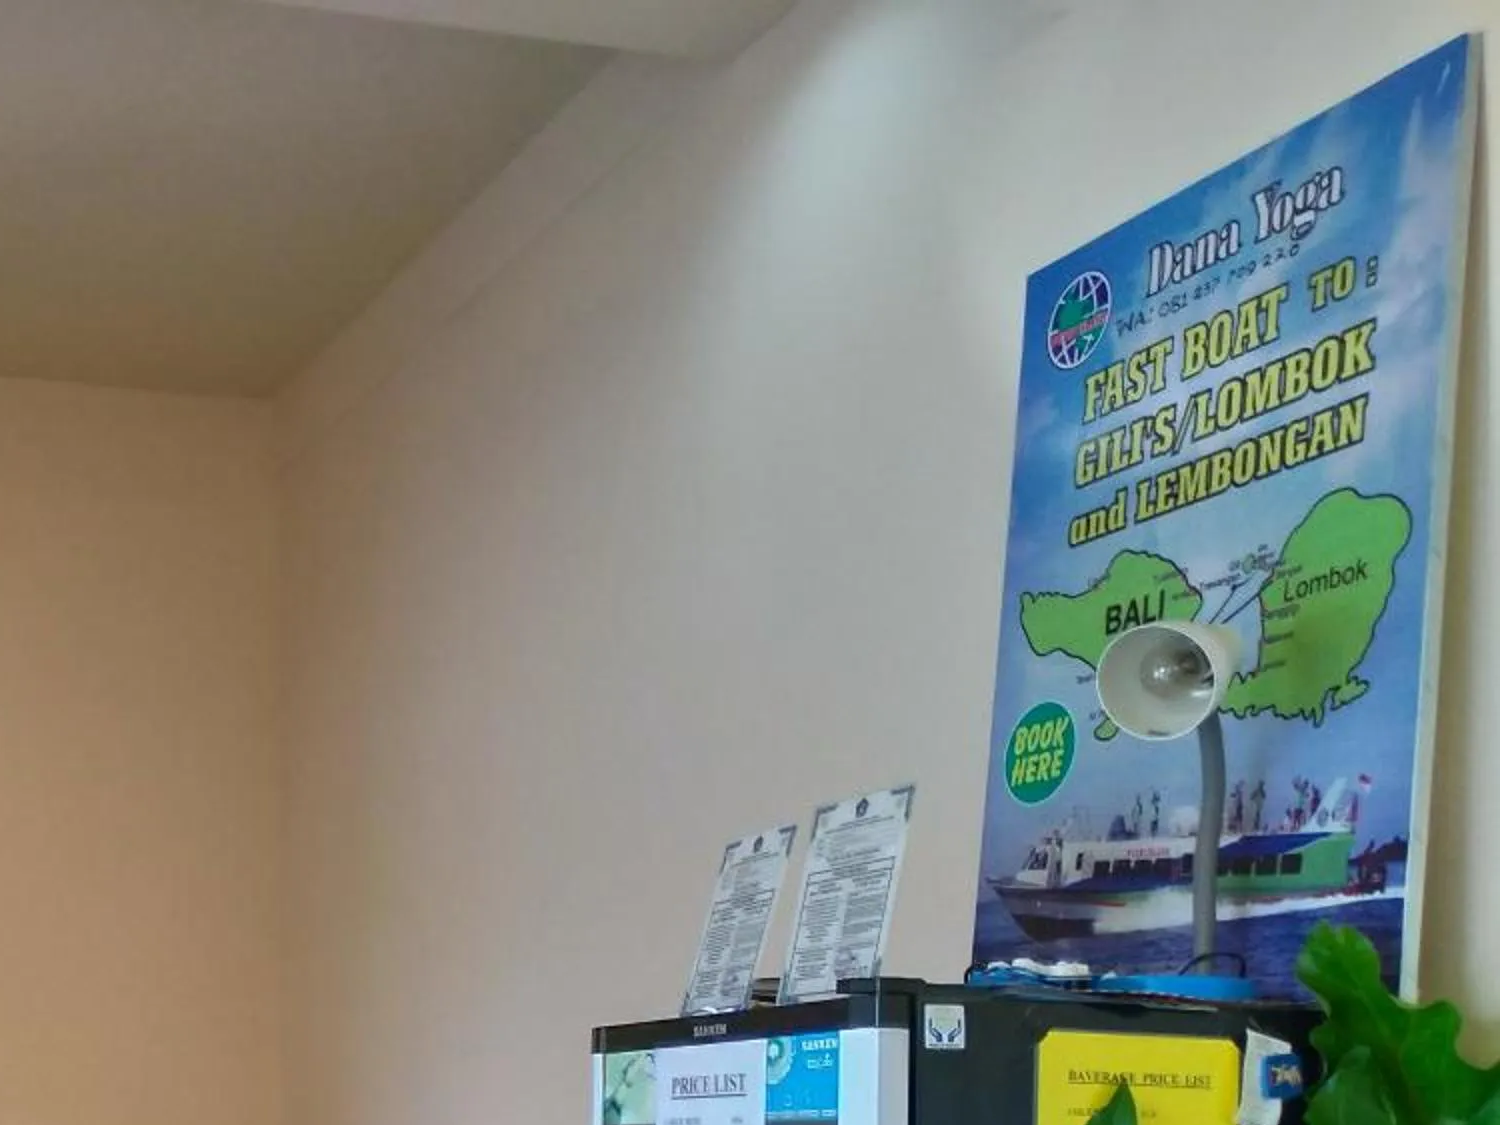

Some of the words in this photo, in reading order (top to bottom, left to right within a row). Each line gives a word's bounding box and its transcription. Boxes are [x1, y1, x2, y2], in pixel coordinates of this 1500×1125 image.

[1145, 220, 1241, 297] Dana
[1251, 166, 1345, 242] Yoga
[1081, 337, 1175, 425] FAST
[1181, 285, 1289, 381] BOAT
[1309, 255, 1357, 313] TO
[1068, 489, 1127, 547] and
[1132, 393, 1369, 524] LEMBONGAN
[1282, 559, 1369, 602] Lombok
[1104, 590, 1165, 636] BALI
[1014, 716, 1068, 756] BOOK
[1011, 749, 1063, 787] HERE
[671, 1075, 709, 1095] PRICE
[714, 1073, 746, 1093] LIST
[1143, 1073, 1177, 1086] PRICE
[1184, 1075, 1212, 1088] LIST
